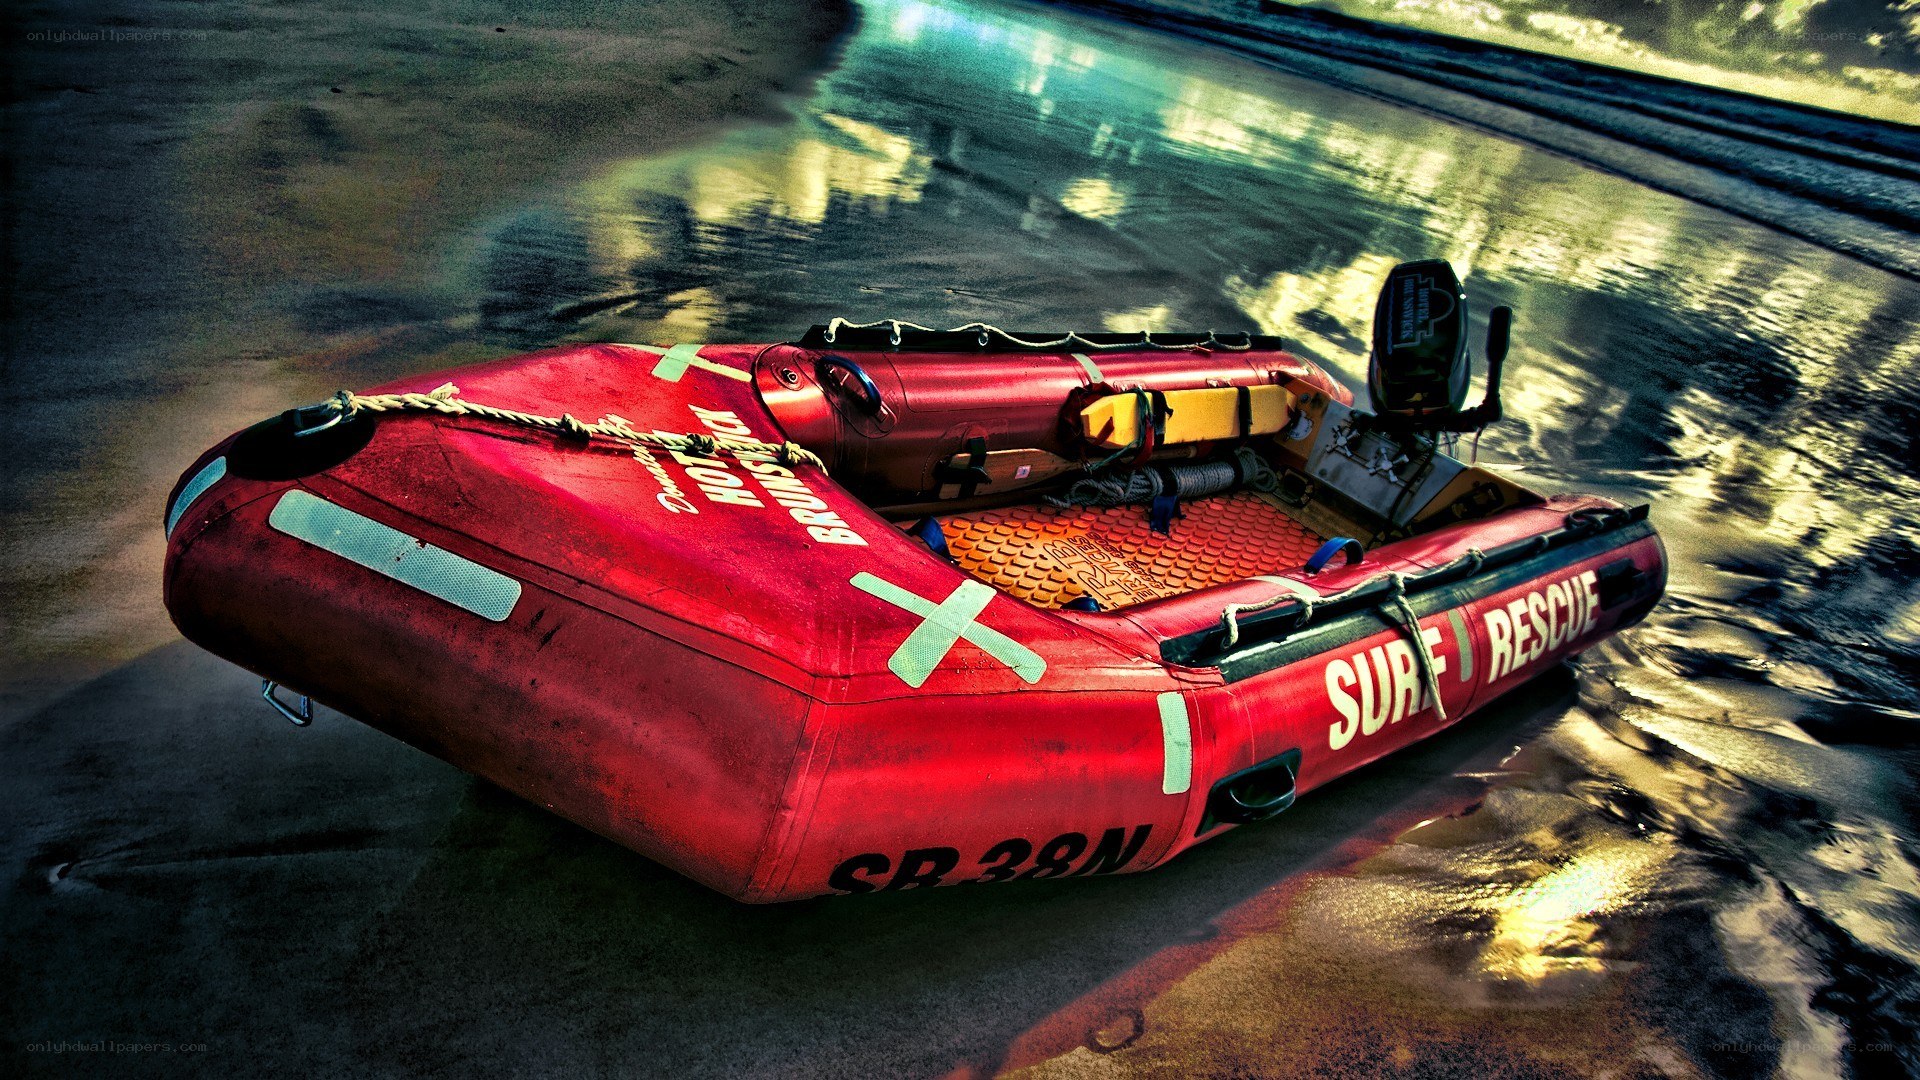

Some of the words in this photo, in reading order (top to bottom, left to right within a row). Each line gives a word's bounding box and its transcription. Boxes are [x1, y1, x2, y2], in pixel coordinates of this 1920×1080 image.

[1416, 288, 1429, 323] HOTEL
[1325, 626, 1447, 750] SURF
[1484, 570, 1599, 683] RESCUE
[960, 824, 1154, 883] 38N
